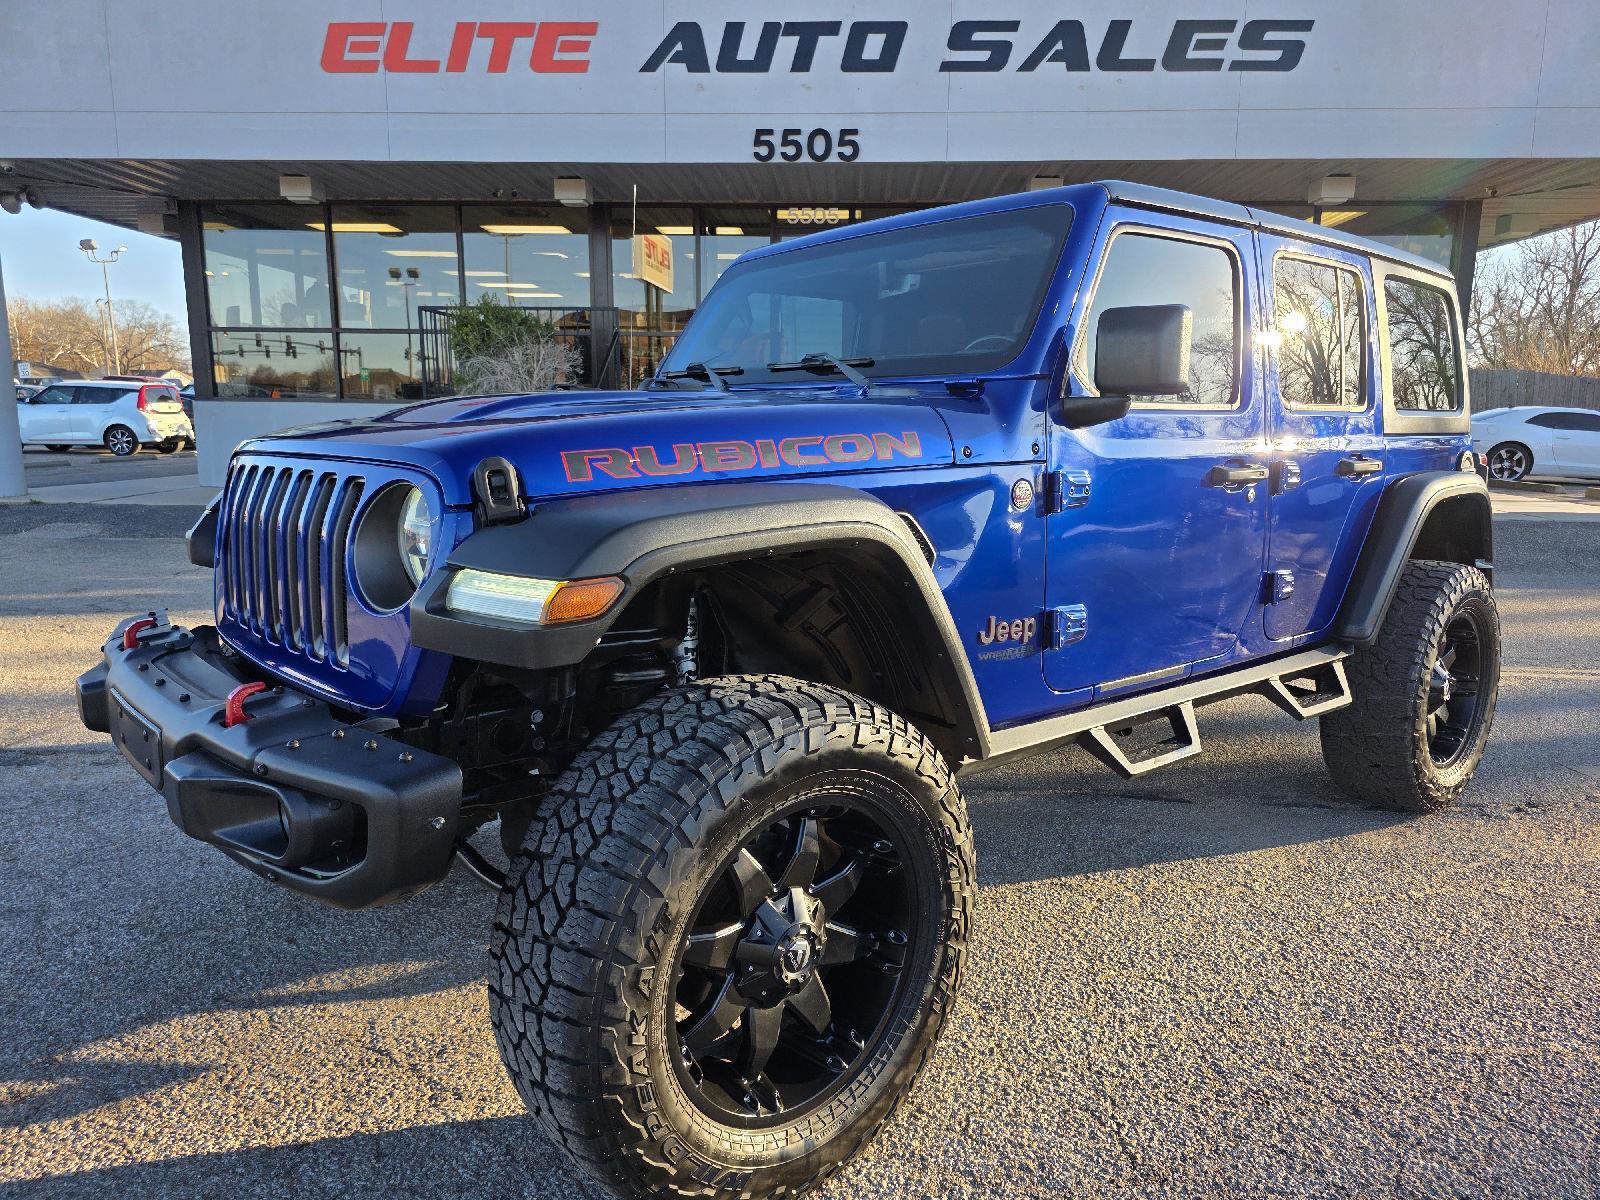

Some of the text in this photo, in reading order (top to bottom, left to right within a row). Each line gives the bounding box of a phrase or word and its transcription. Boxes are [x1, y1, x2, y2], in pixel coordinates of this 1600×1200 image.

[320, 20, 1315, 73] ELITE AUTO SALES
[753, 127, 860, 162] 5505
[786, 207, 841, 225] 5505
[559, 431, 923, 483] RUBICON
[978, 615, 1037, 646] Jeep
